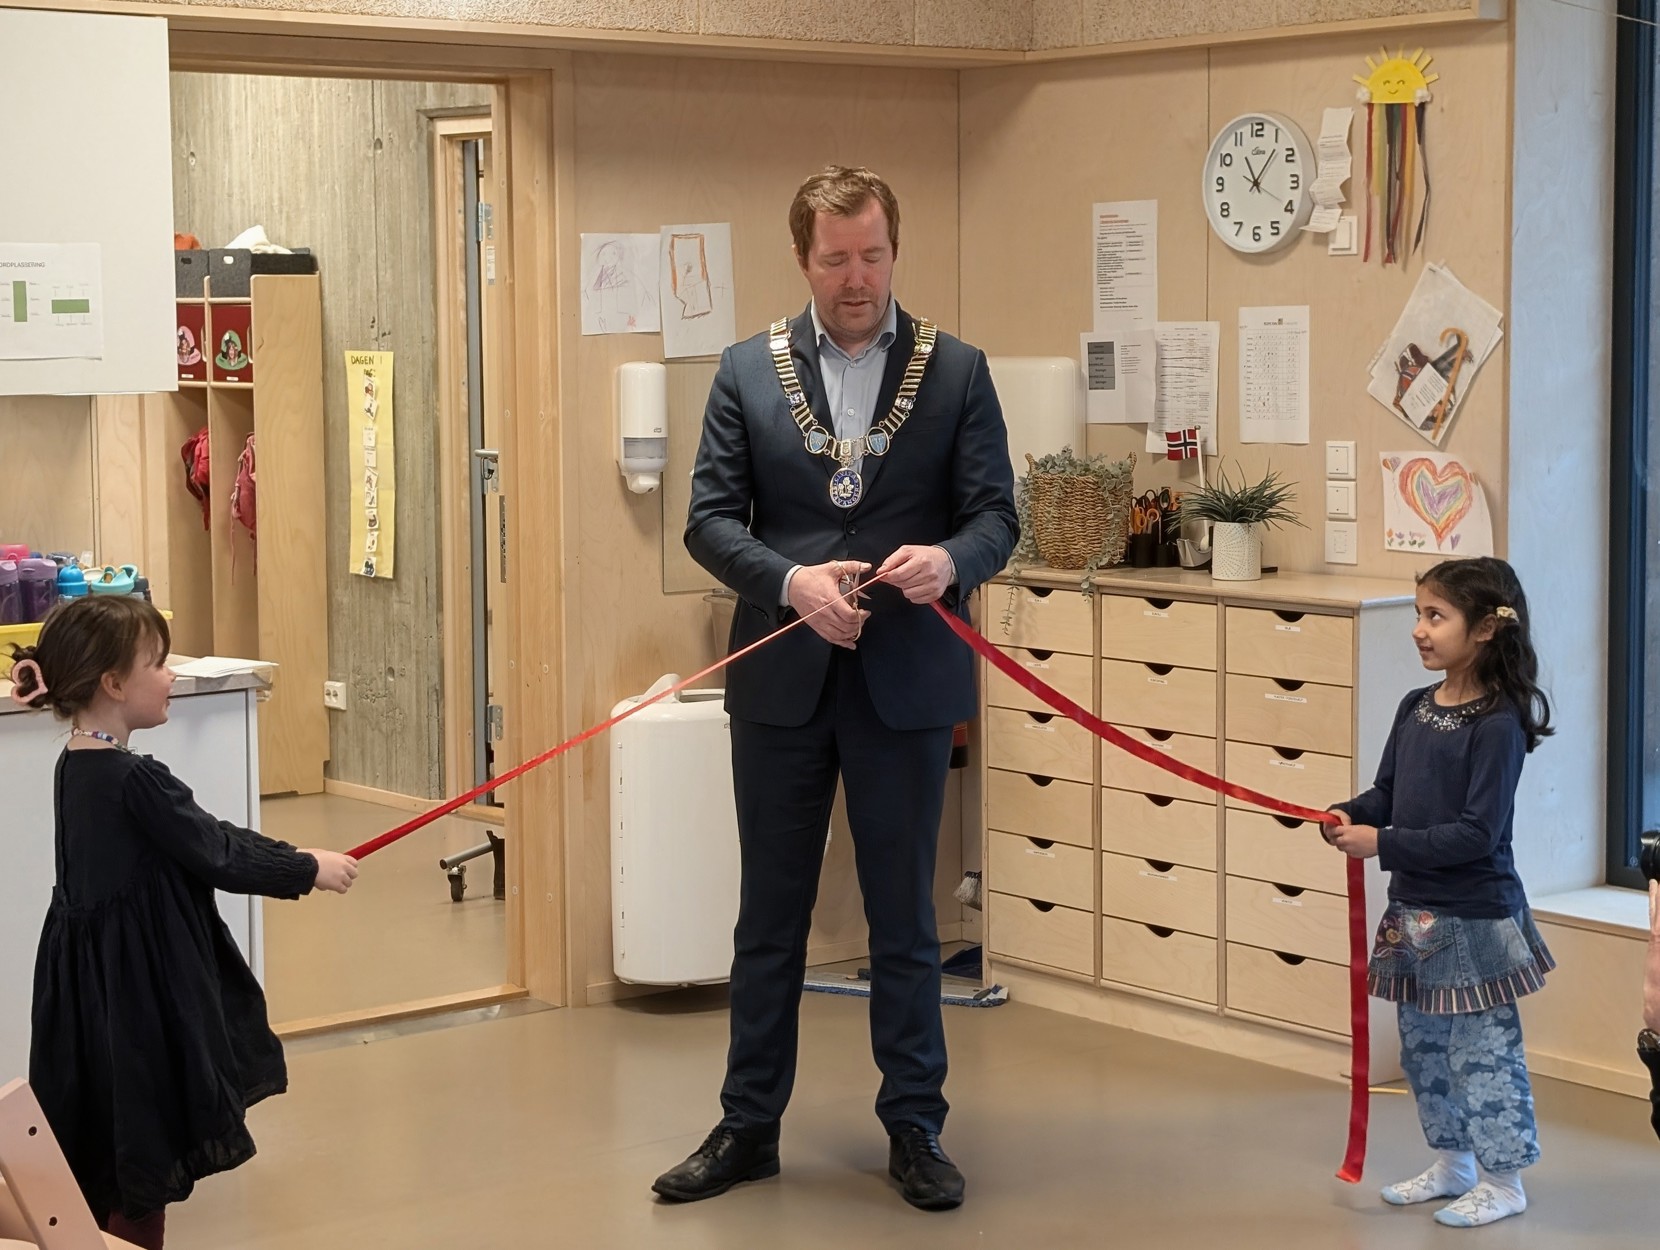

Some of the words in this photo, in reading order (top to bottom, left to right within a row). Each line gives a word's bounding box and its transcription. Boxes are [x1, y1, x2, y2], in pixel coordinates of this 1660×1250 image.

[1250, 122, 1265, 138] 12
[1274, 128, 1279, 143] 1
[1234, 131, 1243, 146] 11
[1219, 153, 1233, 167] 10
[1285, 147, 1295, 163] 2
[1215, 176, 1225, 192] 9
[1290, 174, 1299, 190] 3
[1220, 202, 1230, 218] 8
[1284, 200, 1294, 214] 4
[1233, 221, 1243, 236] 7
[1252, 226, 1261, 242] 6
[1270, 220, 1280, 236] 5
[350, 355, 375, 365] DAGEN
